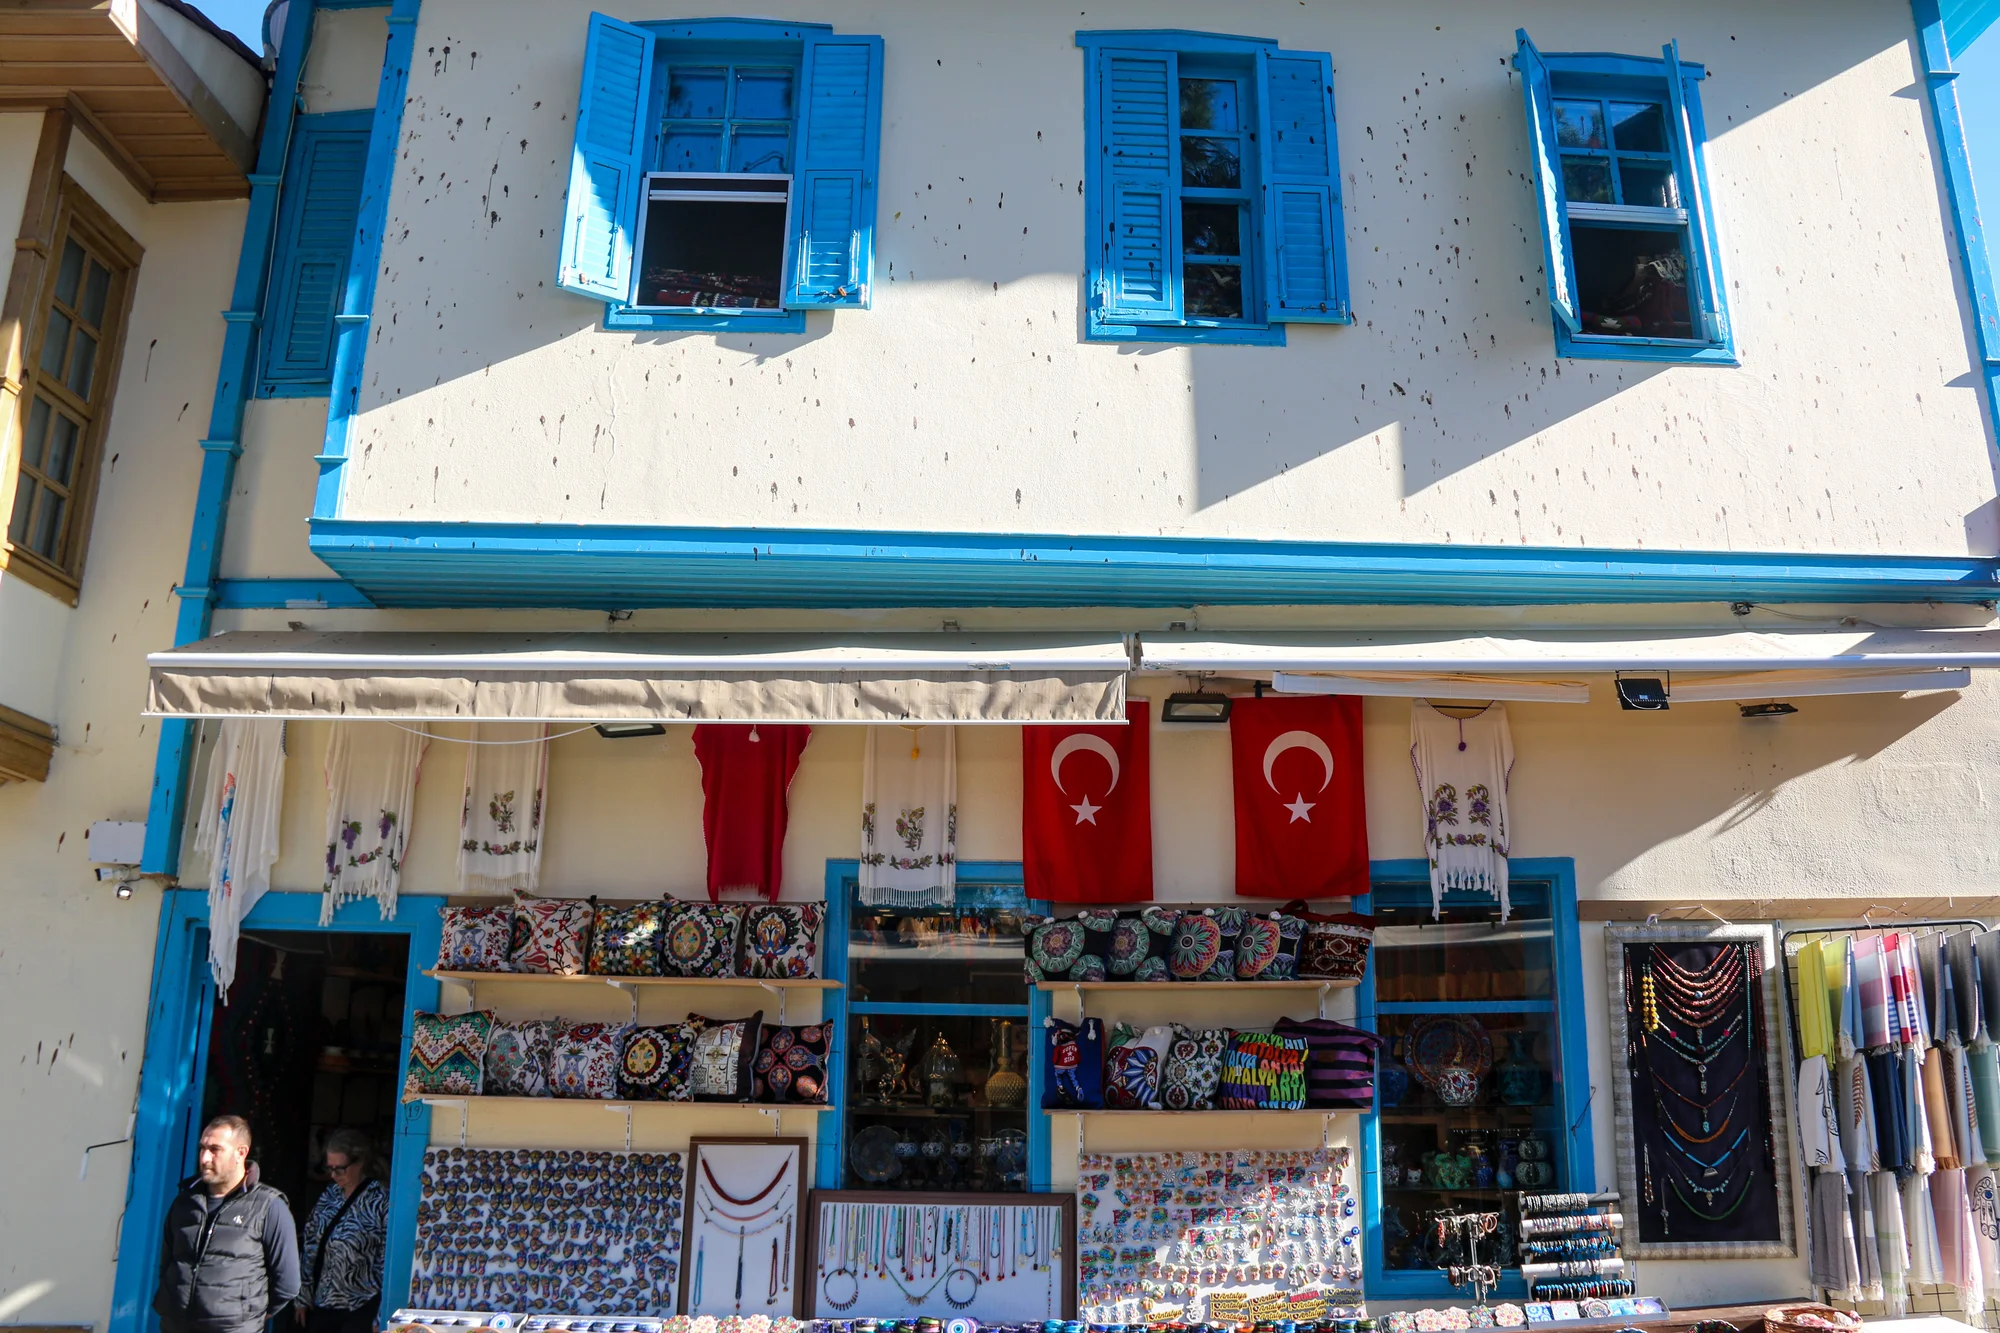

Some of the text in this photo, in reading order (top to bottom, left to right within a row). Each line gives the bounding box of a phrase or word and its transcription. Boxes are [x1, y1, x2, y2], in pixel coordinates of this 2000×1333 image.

[1238, 1041, 1299, 1064] ANTALYA
[1220, 1292, 1247, 1300] Antalya
[1258, 1291, 1286, 1302] Antalya
[1219, 1301, 1248, 1310] Antalya
[1258, 1302, 1286, 1311] Antalya
[1297, 1299, 1325, 1308] Antalya
[1154, 1310, 1182, 1319] Antalya
[1219, 1312, 1248, 1322] Antalya
[1298, 1309, 1326, 1318] Antalya
